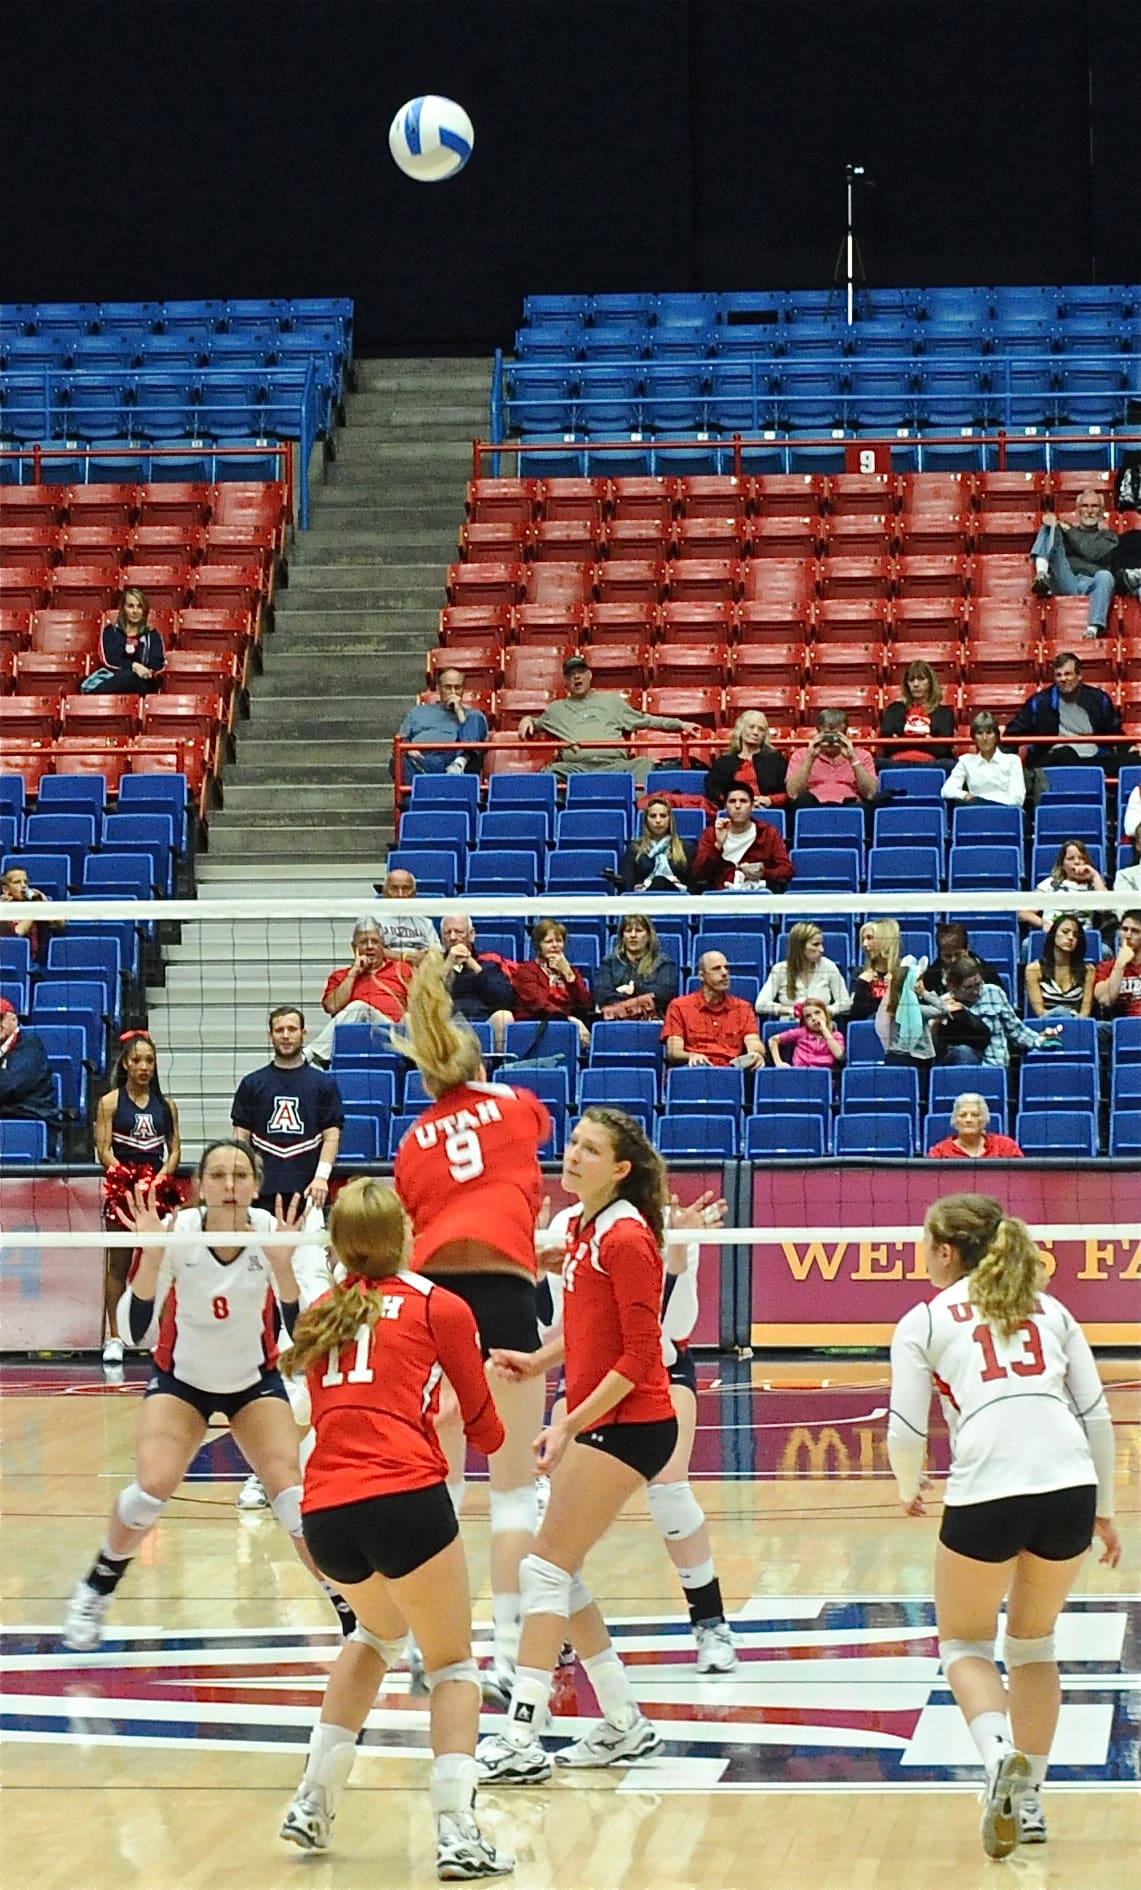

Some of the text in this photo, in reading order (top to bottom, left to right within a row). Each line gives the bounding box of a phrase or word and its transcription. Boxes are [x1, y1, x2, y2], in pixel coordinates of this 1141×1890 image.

[860, 450, 875, 474] 9
[130, 1113, 157, 1138] A
[267, 1096, 304, 1134] A
[414, 1098, 503, 1149] UTAH
[445, 1129, 484, 1183] 9
[781, 1241, 1057, 1281] WELS
[213, 1295, 229, 1320] 8
[322, 1323, 374, 1388] 11
[972, 1319, 1047, 1383] 13
